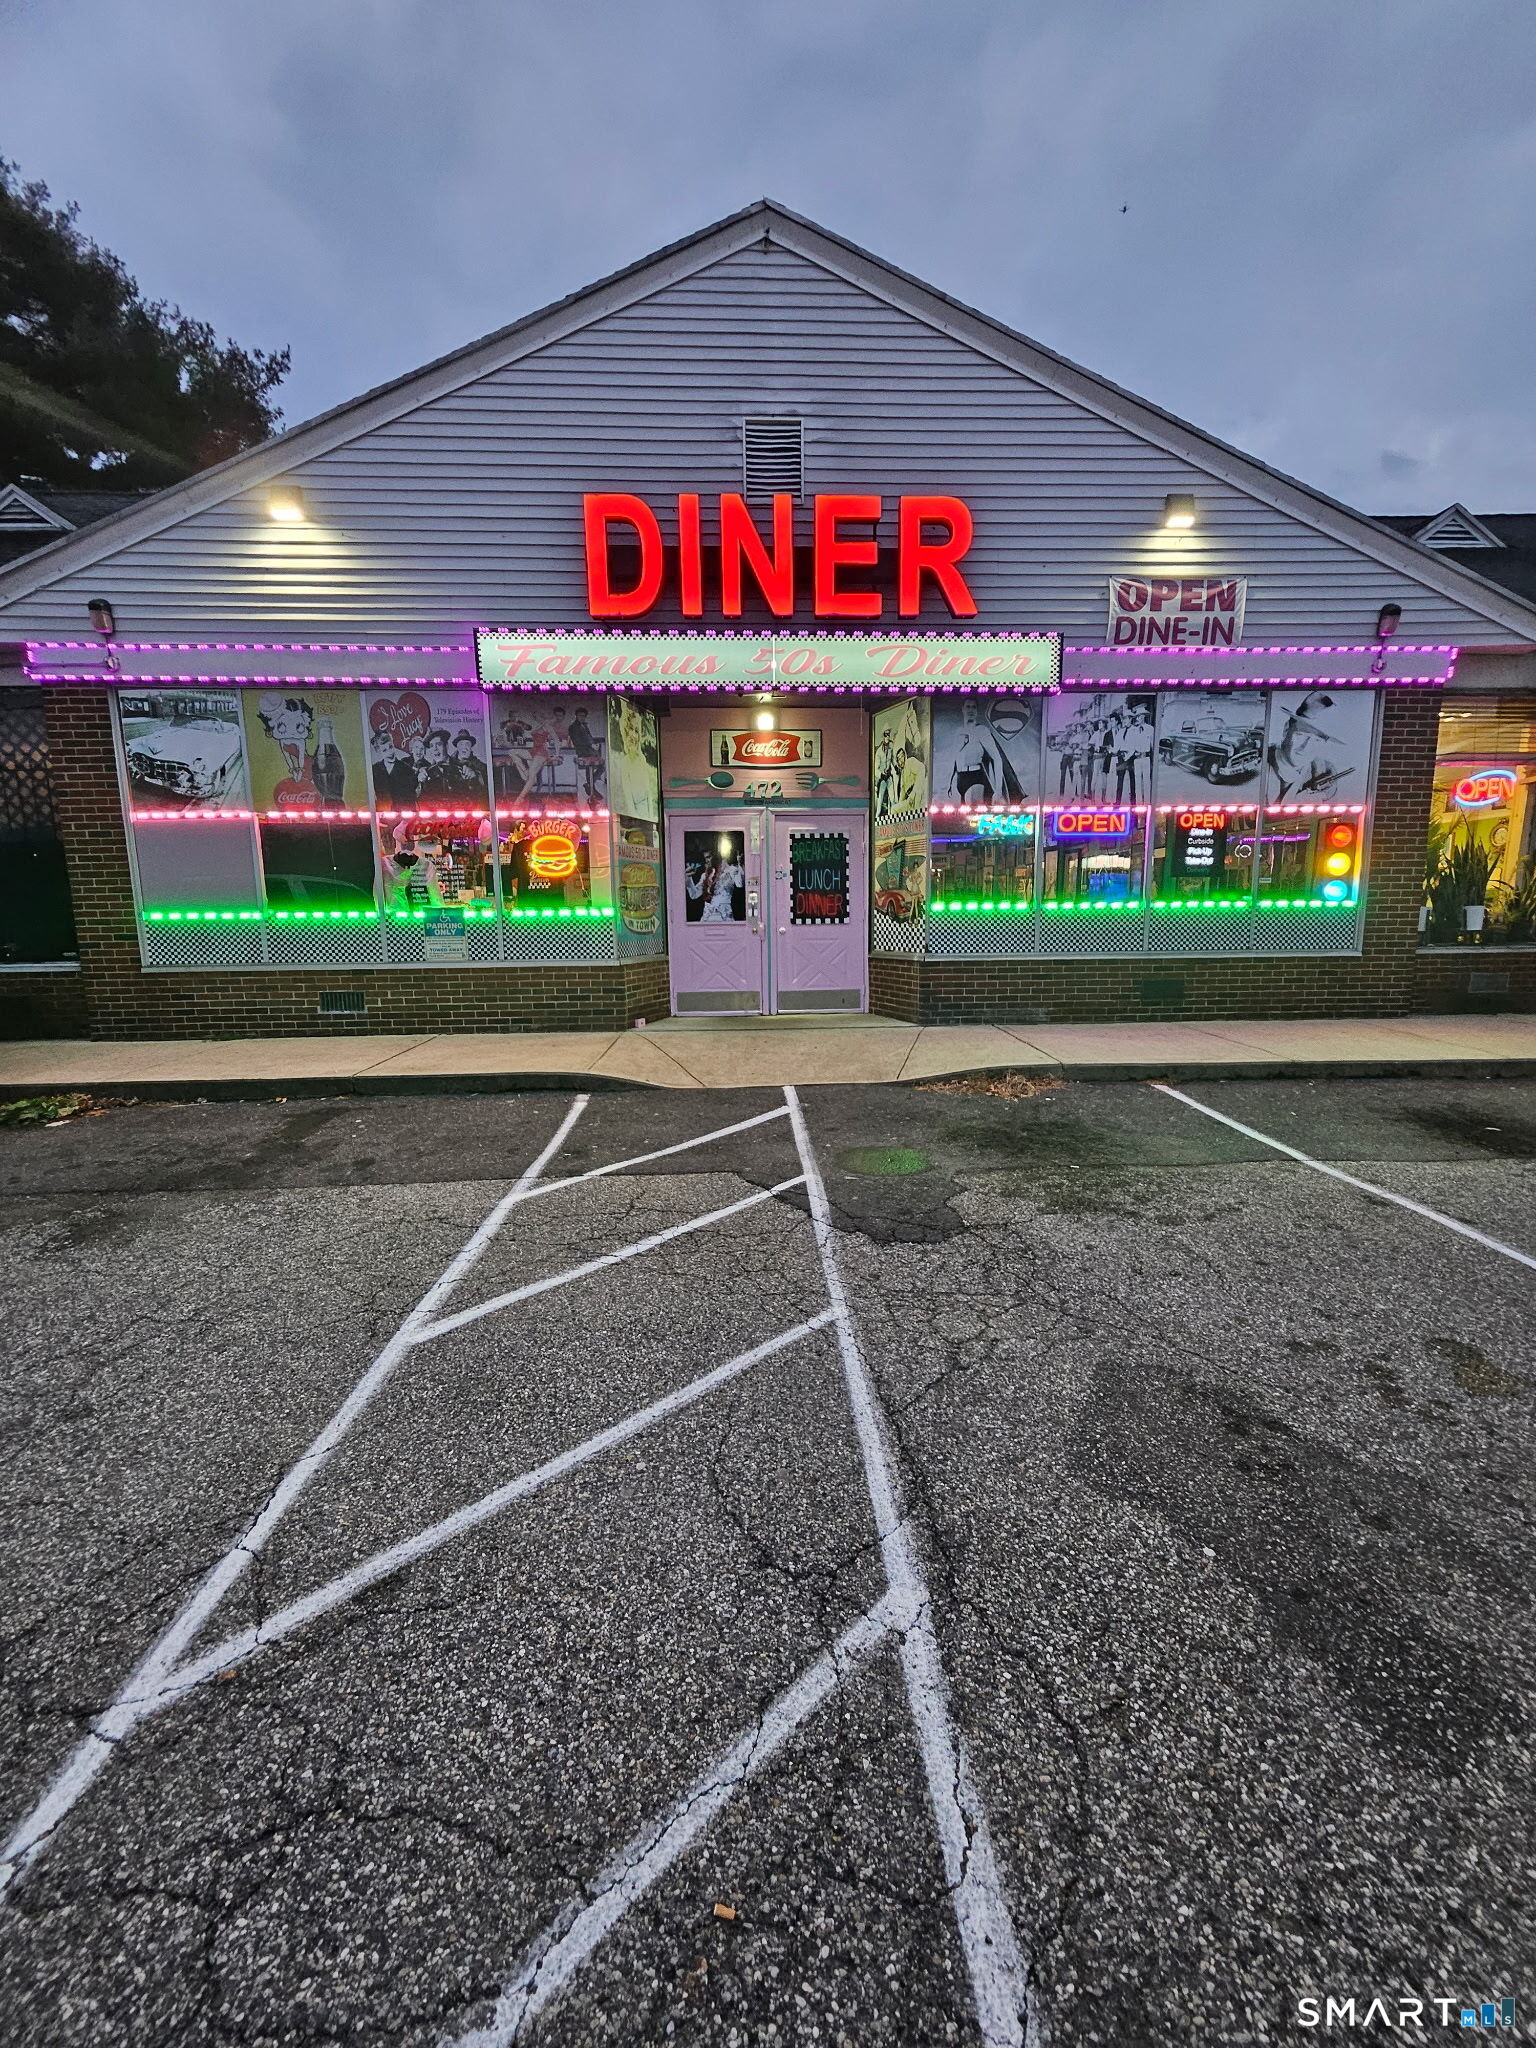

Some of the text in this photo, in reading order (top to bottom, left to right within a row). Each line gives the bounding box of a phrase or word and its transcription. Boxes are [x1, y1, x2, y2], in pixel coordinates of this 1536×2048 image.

[583, 493, 978, 619] DINER
[1118, 578, 1237, 612] OPEN
[1114, 616, 1235, 645] DINE-IN
[496, 643, 1038, 677] Famous 50s Diner
[389, 703, 414, 731] Love
[399, 714, 424, 749] Lucy
[744, 780, 783, 798] 472
[1457, 777, 1515, 800] OPEN
[528, 820, 577, 839] BURGER
[1058, 813, 1126, 832] OPEN
[1180, 813, 1225, 829] OPEN
[792, 839, 847, 863] BREAKFAST
[1187, 837, 1214, 845] Curbside
[798, 868, 841, 890] LUNCH
[796, 892, 844, 916] DINNER
[434, 928, 457, 936] ONLY
[636, 917, 656, 930] TOWN
